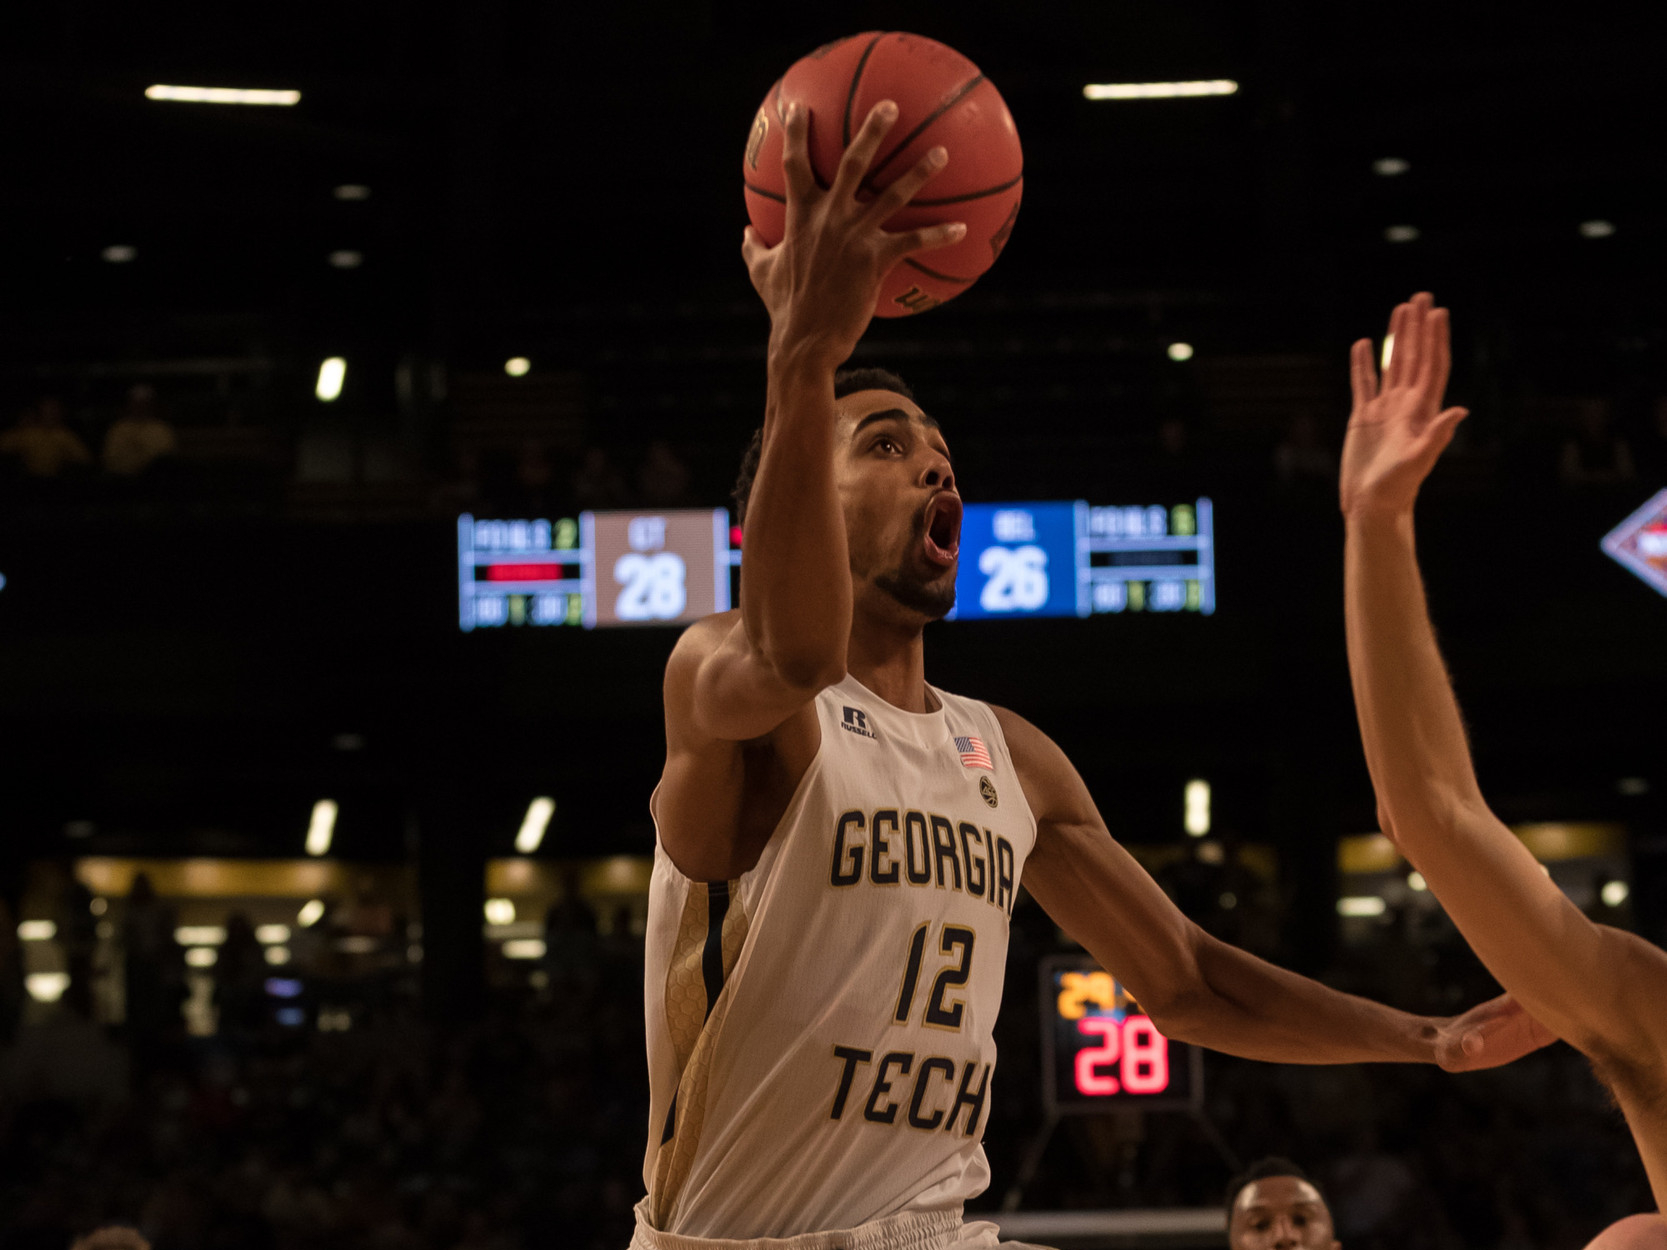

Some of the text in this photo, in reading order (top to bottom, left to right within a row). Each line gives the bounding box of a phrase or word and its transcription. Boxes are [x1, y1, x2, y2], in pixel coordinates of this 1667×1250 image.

[613, 552, 686, 620] 28
[978, 545, 1048, 611] 26
[840, 721, 877, 740] RUSSELL
[830, 808, 1013, 919] GEORGIA
[893, 920, 976, 1033] 12
[829, 1043, 991, 1138] TECH
[1074, 1015, 1169, 1095] 28
